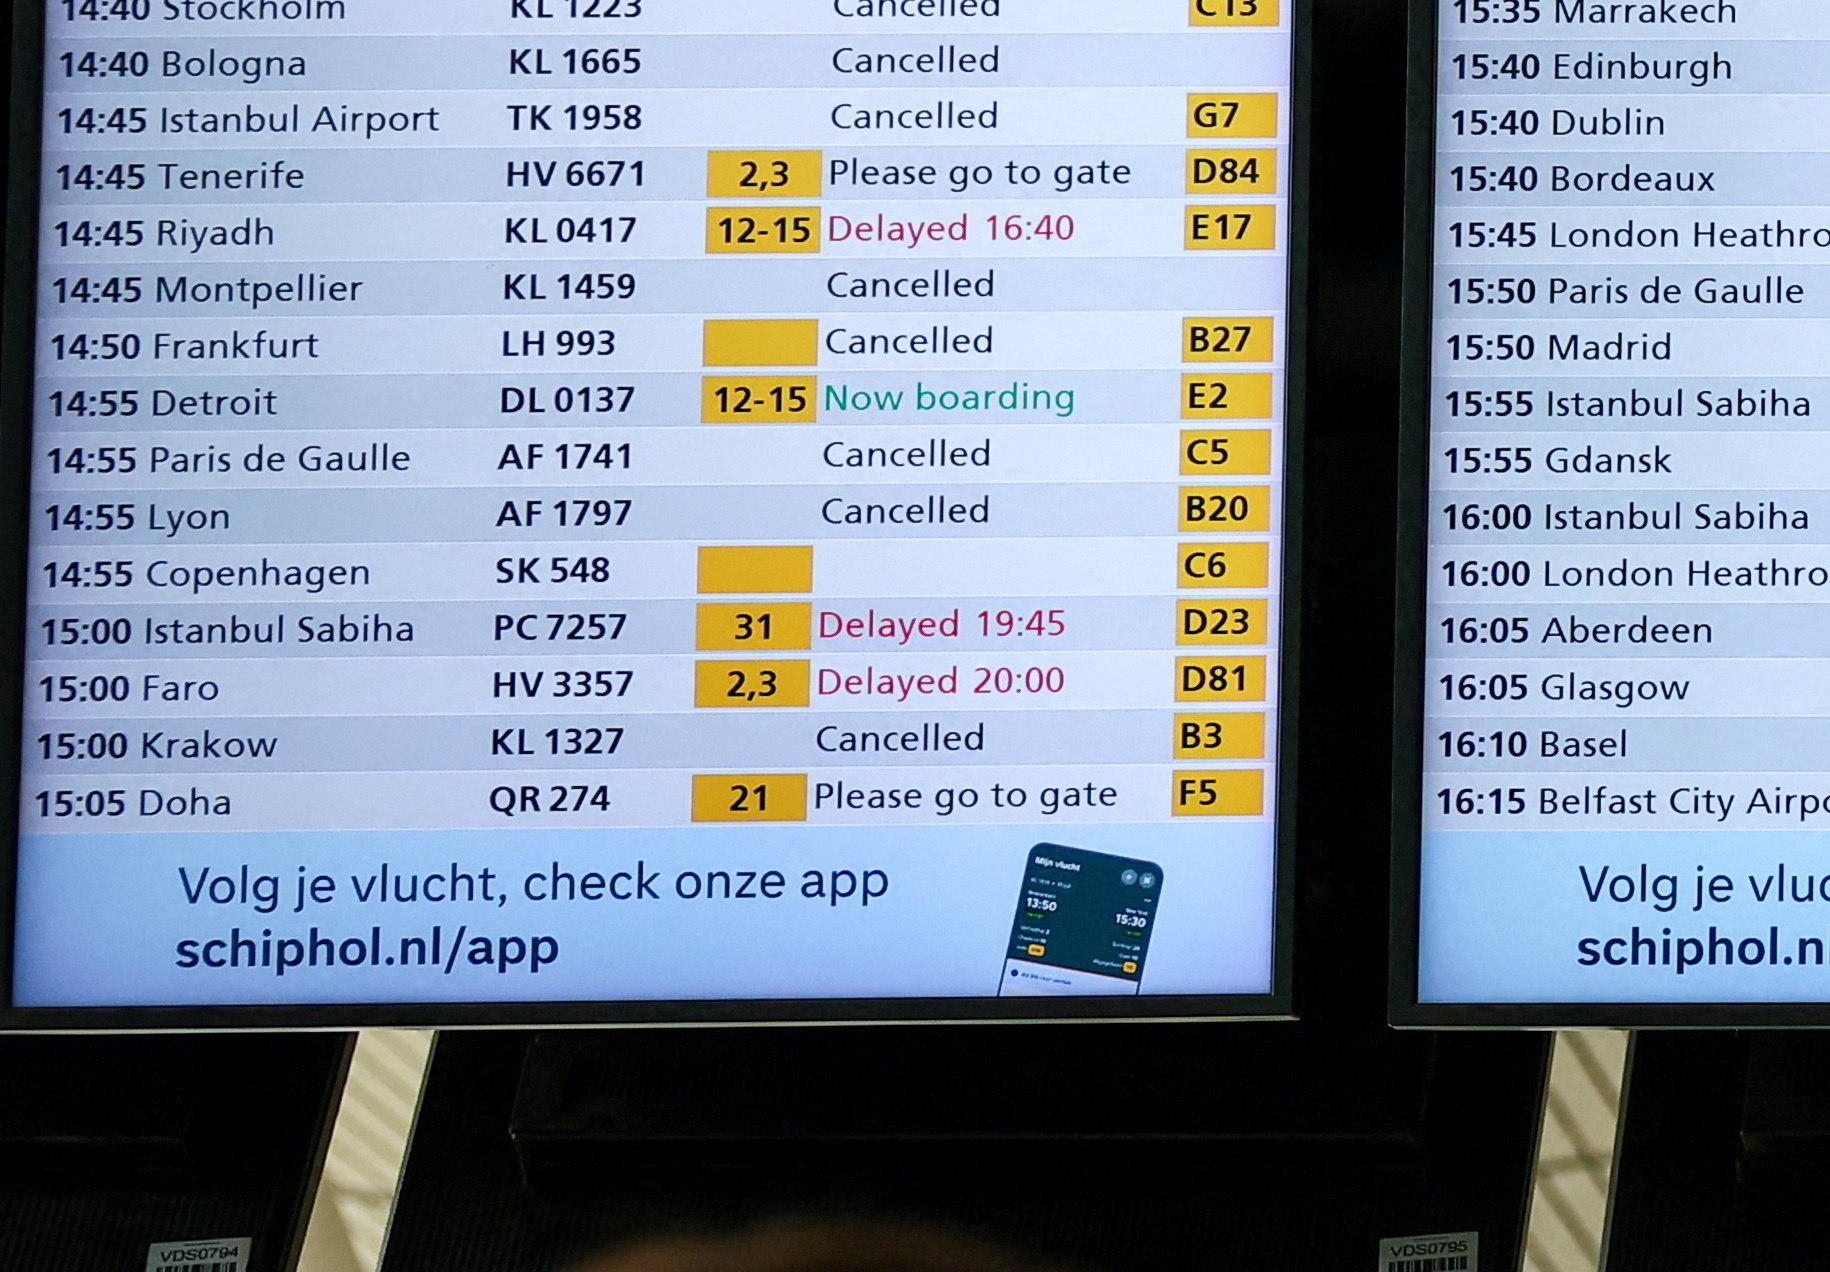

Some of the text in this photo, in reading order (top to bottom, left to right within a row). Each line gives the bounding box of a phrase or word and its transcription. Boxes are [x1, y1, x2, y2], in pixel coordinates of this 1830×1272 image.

[1437, 729, 1529, 759] 16:10
[1539, 727, 1628, 759] Basel
[177, 858, 890, 915] Volg je vlucht, check onze app
[1026, 897, 1058, 912] 13:50
[1115, 913, 1147, 928] 15:30
[174, 924, 560, 978] schiphol.nl/app
[160, 1246, 239, 1263] VDS0794
[1390, 1240, 1468, 1258] VDS0795
